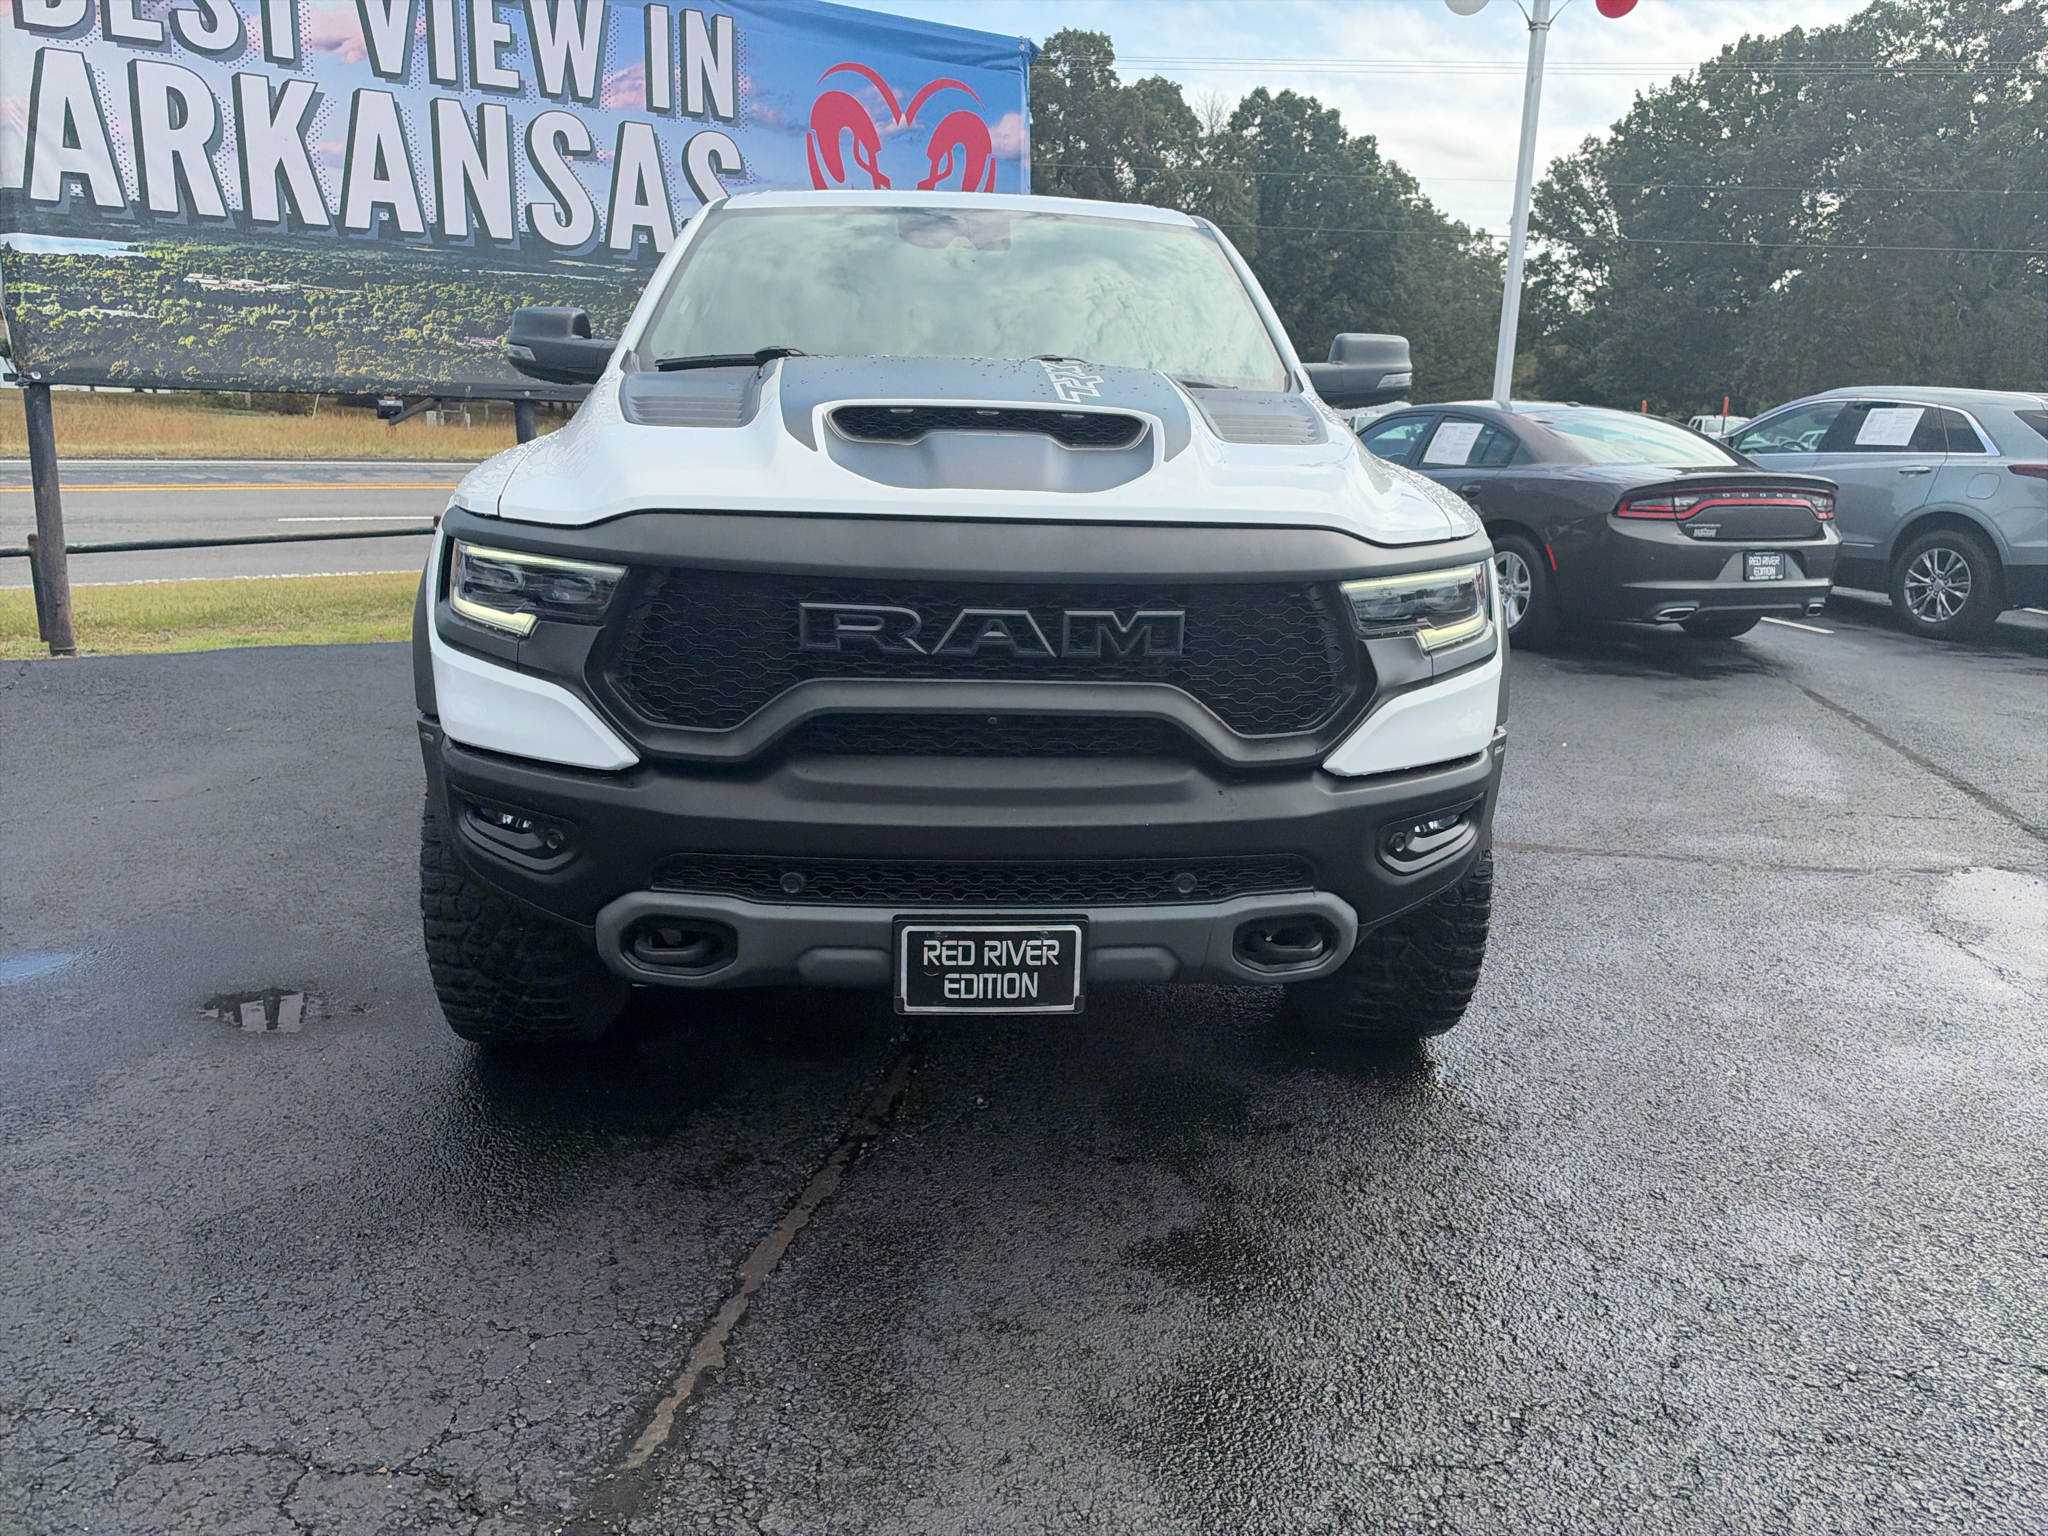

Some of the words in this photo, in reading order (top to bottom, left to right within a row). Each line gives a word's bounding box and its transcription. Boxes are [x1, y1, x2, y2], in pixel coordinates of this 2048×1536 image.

[353, 0, 603, 102] VIEW
[644, 3, 735, 122] IN
[1749, 556, 1761, 565] RED
[1753, 567, 1776, 576] EDITION
[799, 602, 1186, 658] RAM
[923, 940, 975, 966] RED
[983, 940, 1060, 966] RIVER
[944, 972, 1039, 999] EDITION
